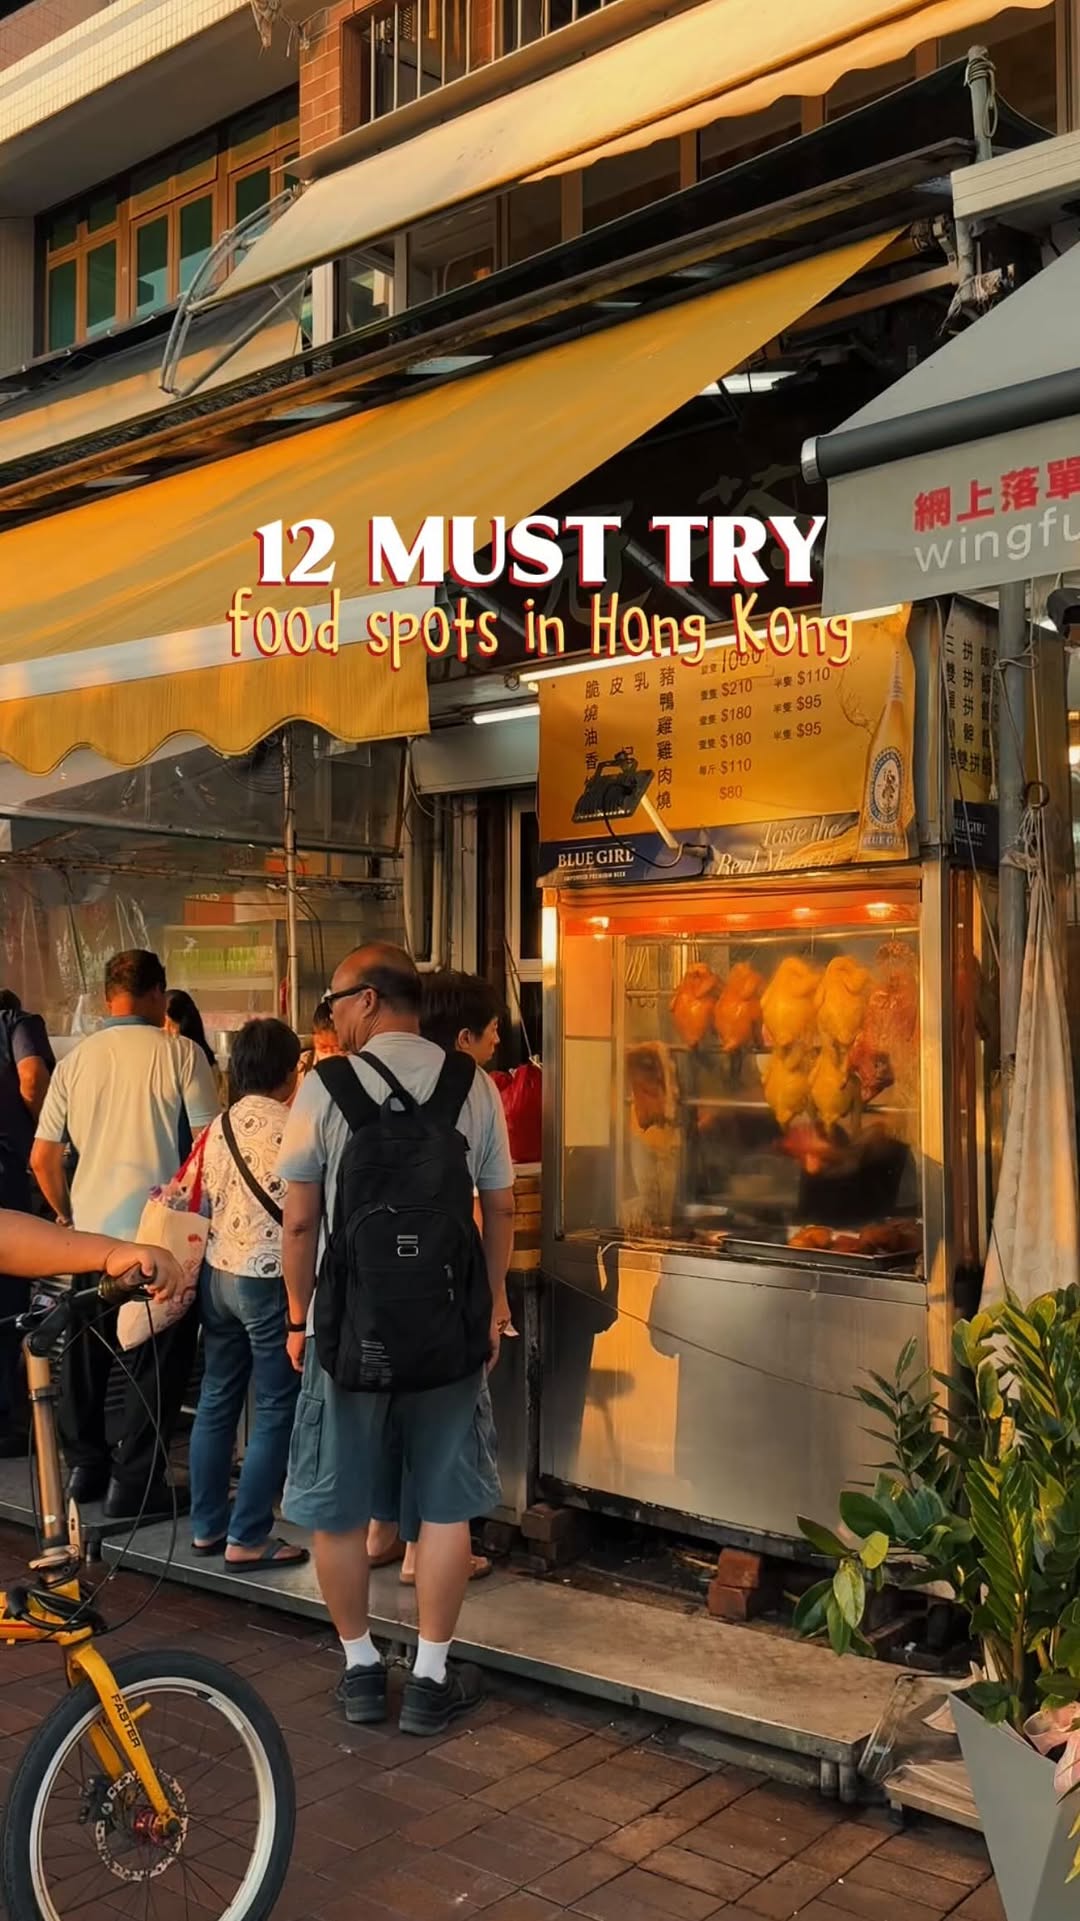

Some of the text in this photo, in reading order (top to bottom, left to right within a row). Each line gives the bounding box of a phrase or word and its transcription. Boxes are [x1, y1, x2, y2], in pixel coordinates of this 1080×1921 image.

[914, 455, 1080, 533] 網上落單
[721, 679, 752, 697] $210
[797, 667, 830, 685] $110
[721, 705, 752, 723] $180
[796, 694, 821, 711] $95
[720, 731, 752, 749] $180
[796, 721, 821, 738] $95
[720, 758, 752, 775] $110
[719, 785, 742, 800] $80
[763, 815, 840, 848] Taste the
[558, 847, 635, 868] BLUE GIRL
[717, 850, 759, 875] Real
[111, 1694, 140, 1748] FASTER
